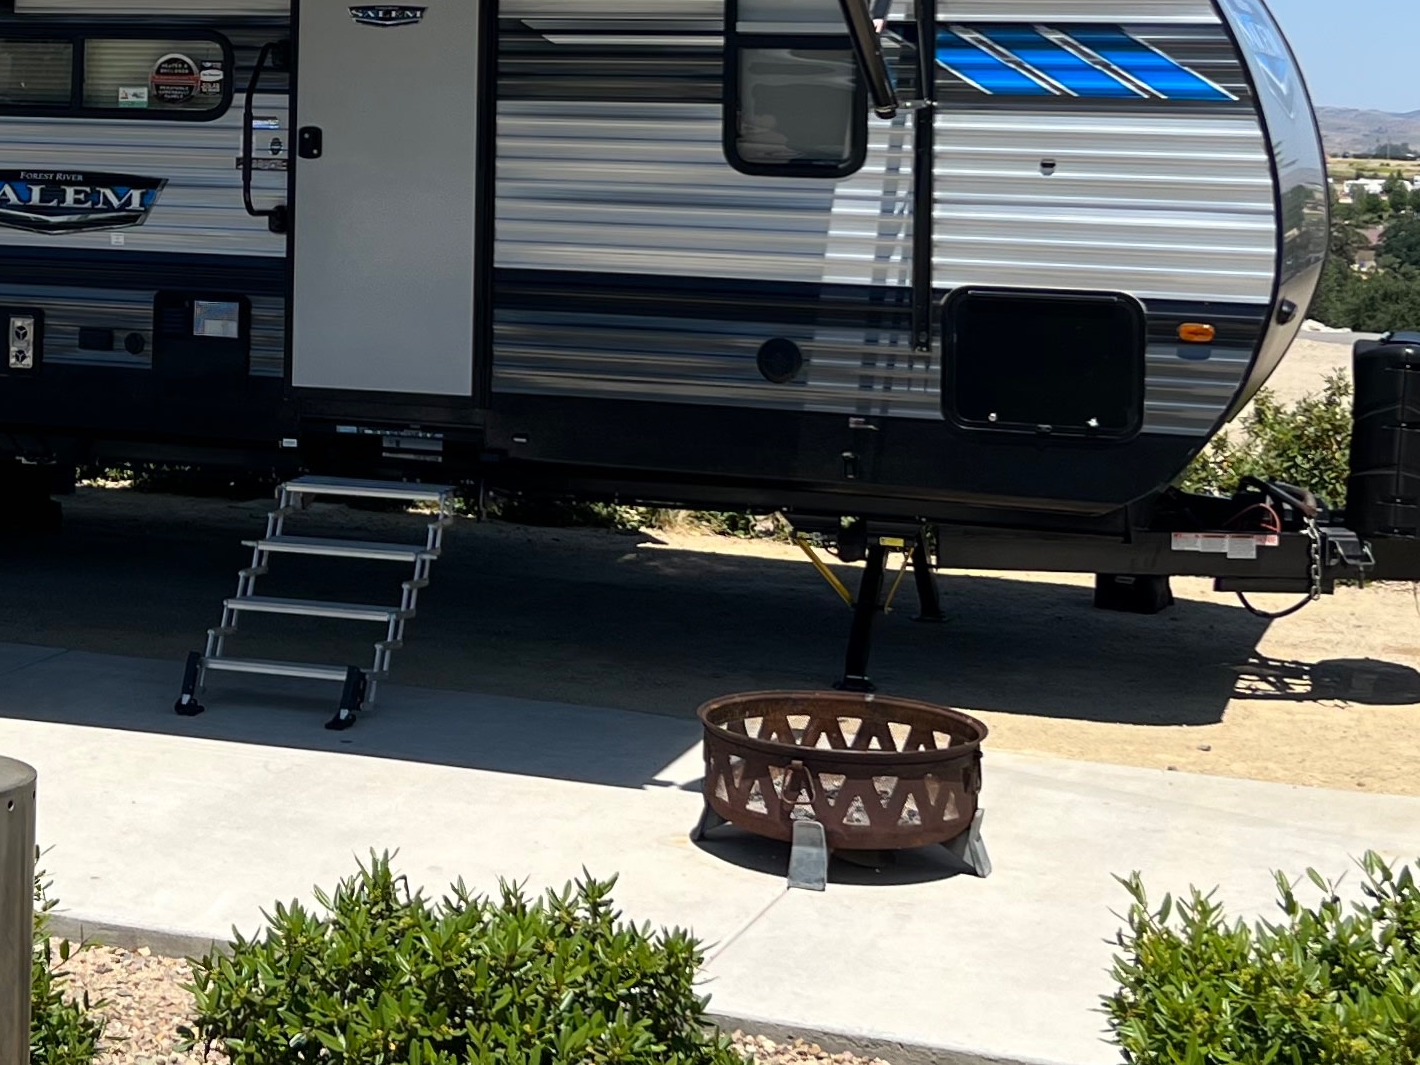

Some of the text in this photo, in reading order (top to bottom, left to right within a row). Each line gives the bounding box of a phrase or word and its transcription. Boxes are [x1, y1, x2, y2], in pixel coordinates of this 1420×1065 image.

[350, 10, 421, 18] SALEM
[19, 171, 84, 182] FOREST RIVER
